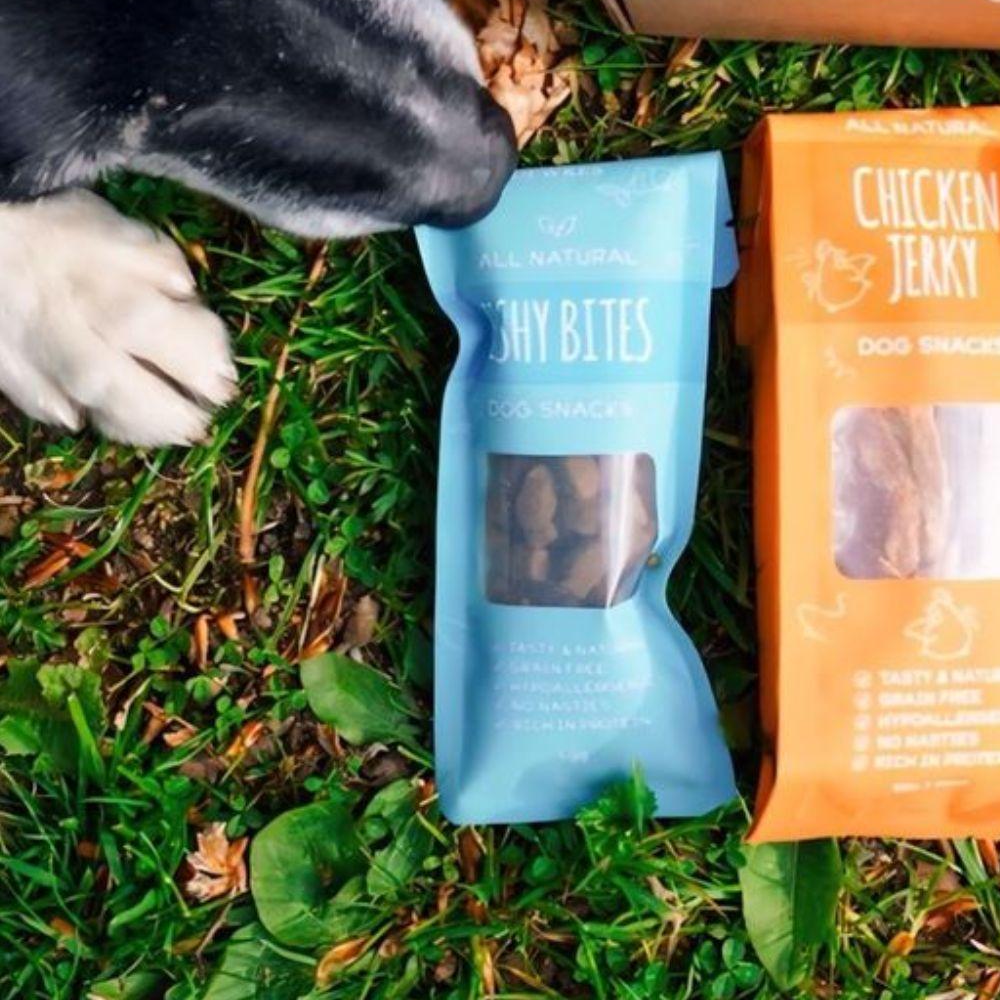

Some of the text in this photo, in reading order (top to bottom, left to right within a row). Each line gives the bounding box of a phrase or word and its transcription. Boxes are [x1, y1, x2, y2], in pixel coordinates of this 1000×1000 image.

[844, 119, 998, 137] ALL NATURAL
[853, 166, 1000, 233] CHICKEN
[479, 247, 638, 269] ALL NATURAL
[887, 234, 978, 304] JERKY
[560, 297, 653, 364] BITES
[858, 336, 909, 357] DOG
[488, 400, 531, 419] DOG
[878, 669, 932, 685] TASTY
[939, 689, 982, 705] FREE
[876, 734, 900, 749] NO
